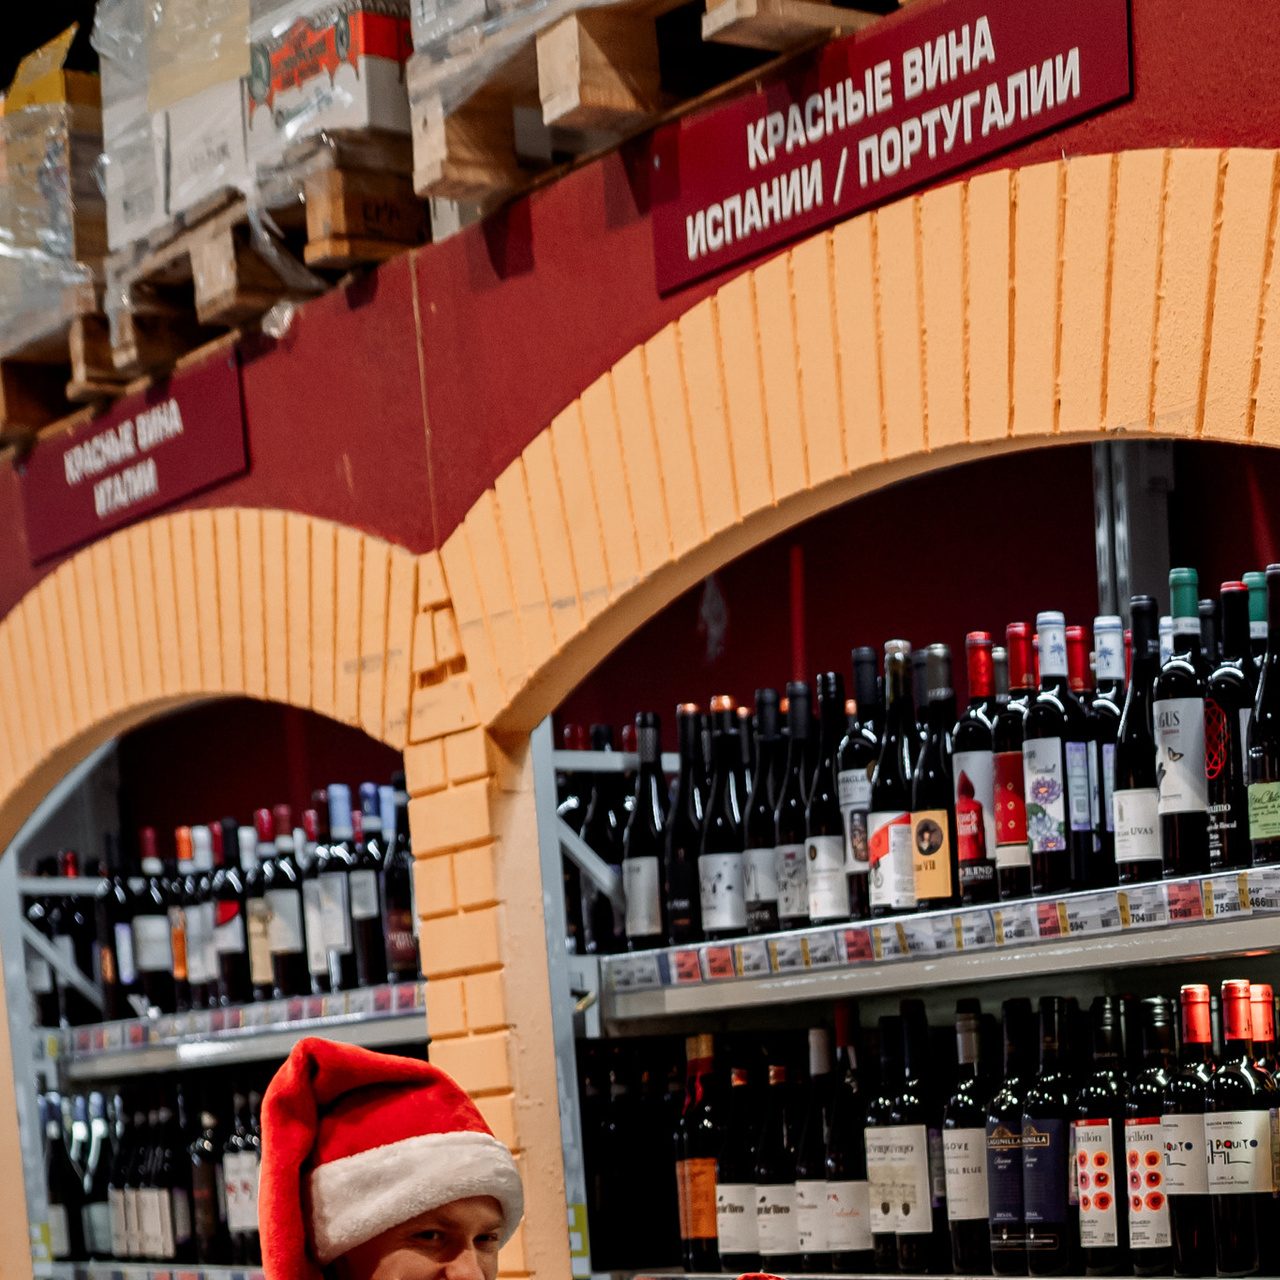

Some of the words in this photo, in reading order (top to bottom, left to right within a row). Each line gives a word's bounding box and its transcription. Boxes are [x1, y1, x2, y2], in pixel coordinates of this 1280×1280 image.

[746, 60, 893, 169] КРАСНЫЕ
[903, 15, 995, 101] ВИНА
[686, 158, 823, 260] ИСПАНИИ
[859, 46, 1081, 188] ПОРТУГАЛИИ
[64, 420, 136, 486] КРАСНЫЕ
[136, 397, 184, 451] ВИНА
[94, 457, 159, 517] ИТАЛИИ
